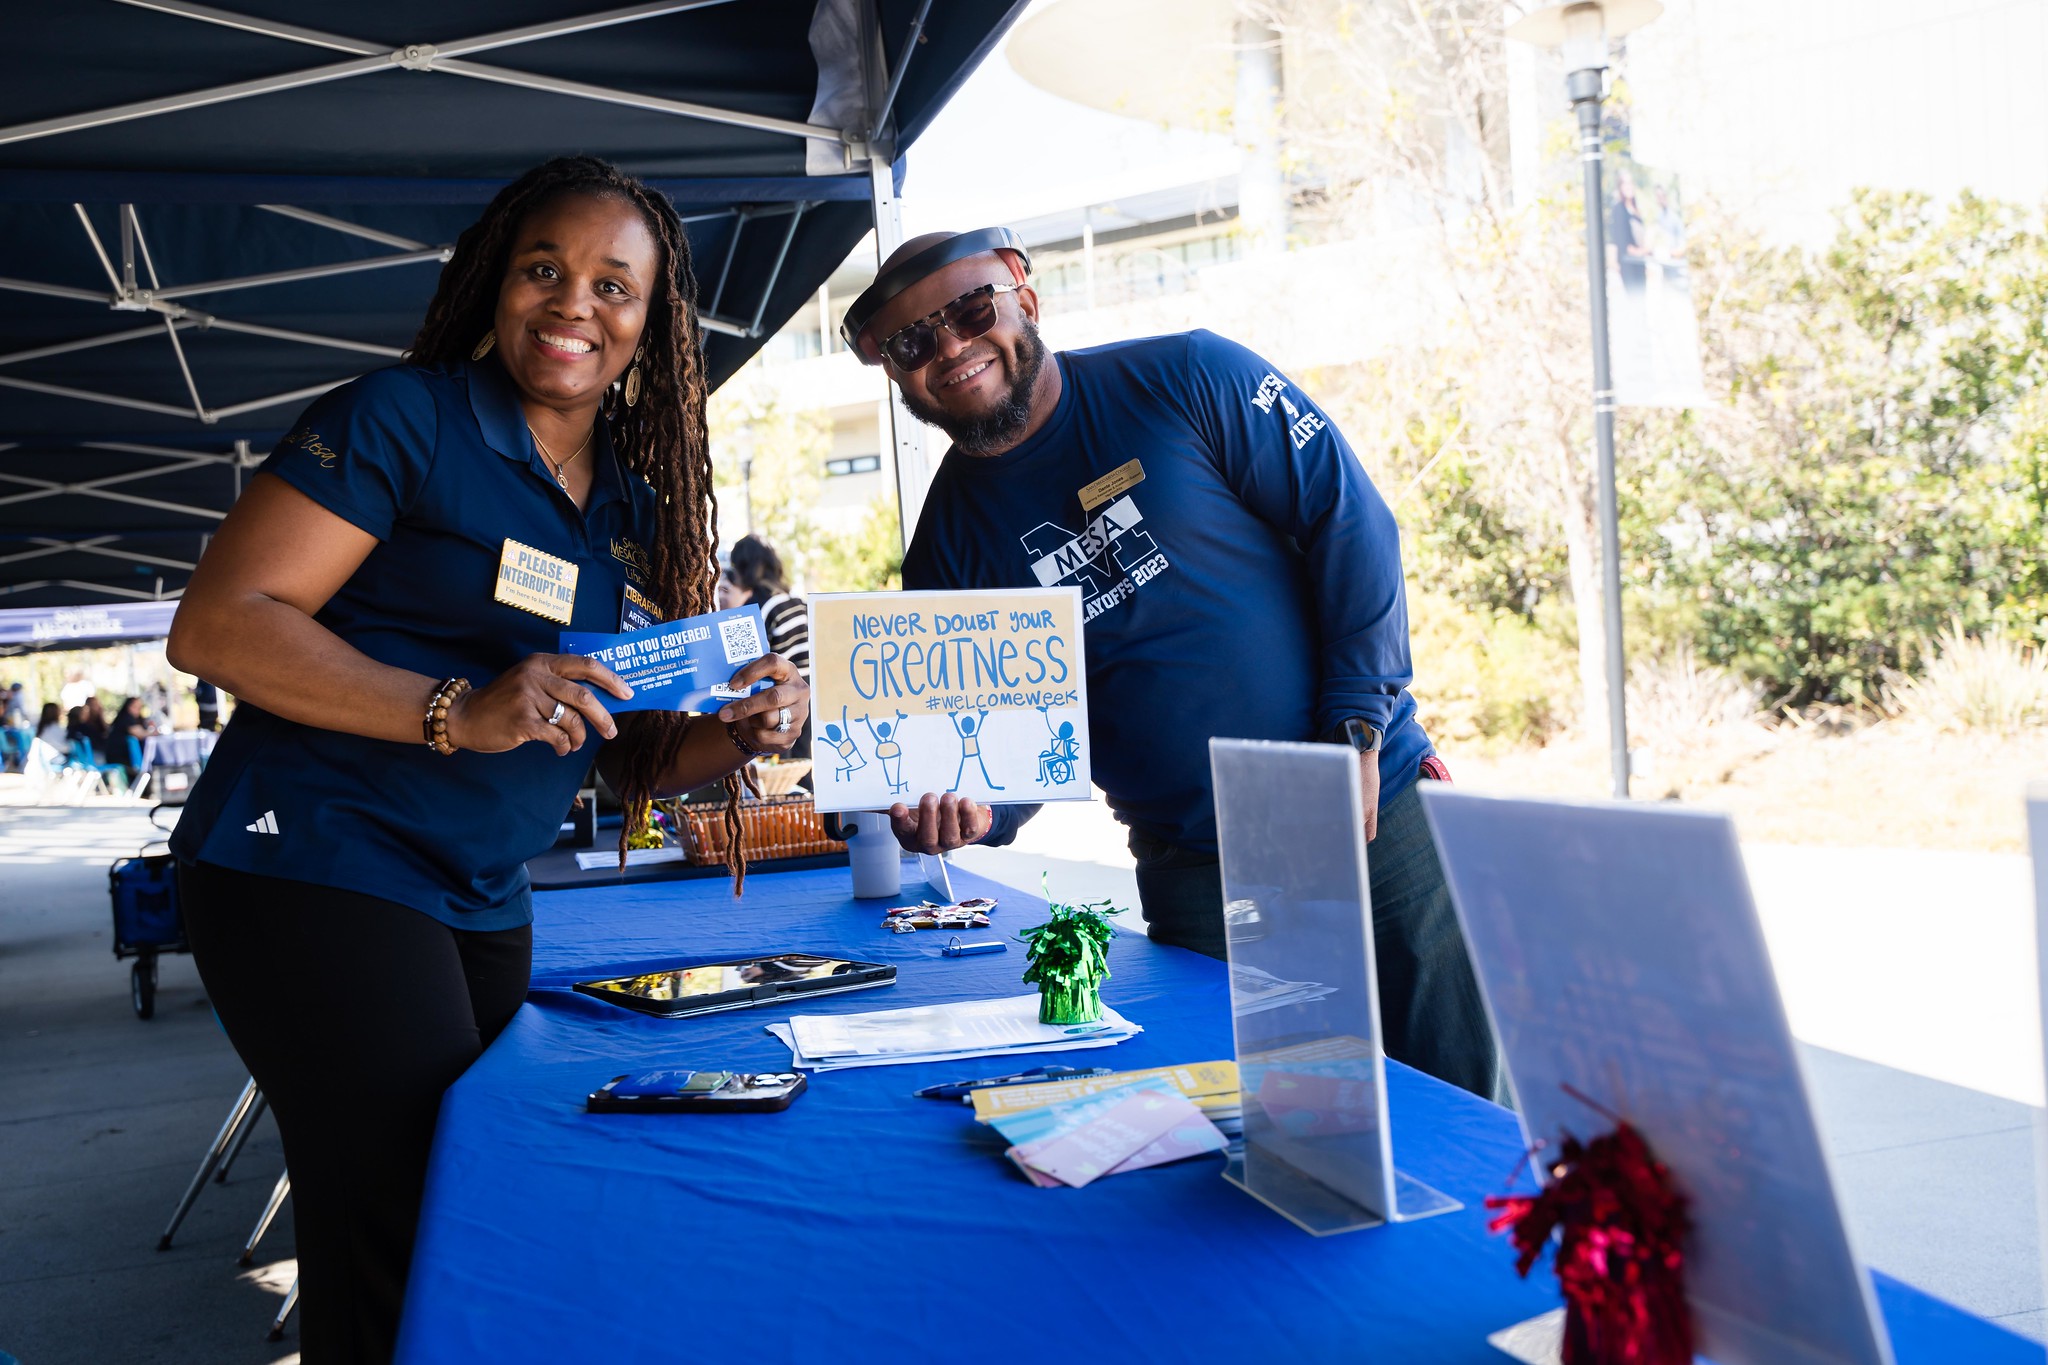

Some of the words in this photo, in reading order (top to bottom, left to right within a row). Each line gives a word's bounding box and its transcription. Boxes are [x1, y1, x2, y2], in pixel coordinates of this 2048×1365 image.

[1251, 372, 1288, 415] MESA
[1280, 395, 1300, 419] 4
[1289, 411, 1327, 450] LIFE
[1111, 476, 1124, 486] Jones
[1053, 513, 1125, 577] MESA
[517, 550, 564, 581] PLEASE
[500, 563, 556, 597] INTERRUPT
[556, 584, 575, 605] ME!
[505, 586, 516, 594] I'm
[516, 590, 530, 600] here
[538, 598, 552, 608] help
[552, 604, 565, 612] you!
[1083, 577, 1136, 625] LAYOFFS
[1131, 552, 1170, 587] 2023
[625, 584, 664, 620] LIBRARIAN
[934, 610, 999, 636] DOUBT
[615, 642, 637, 659] GOT
[636, 637, 660, 654] YOU
[660, 625, 712, 648] COVERED!
[615, 658, 632, 672] And
[632, 653, 648, 669] it's
[648, 651, 661, 664] all
[661, 645, 686, 661] Free!!
[637, 667, 654, 678] MESA
[653, 661, 678, 674] COLLEGE
[681, 657, 699, 667] Library
